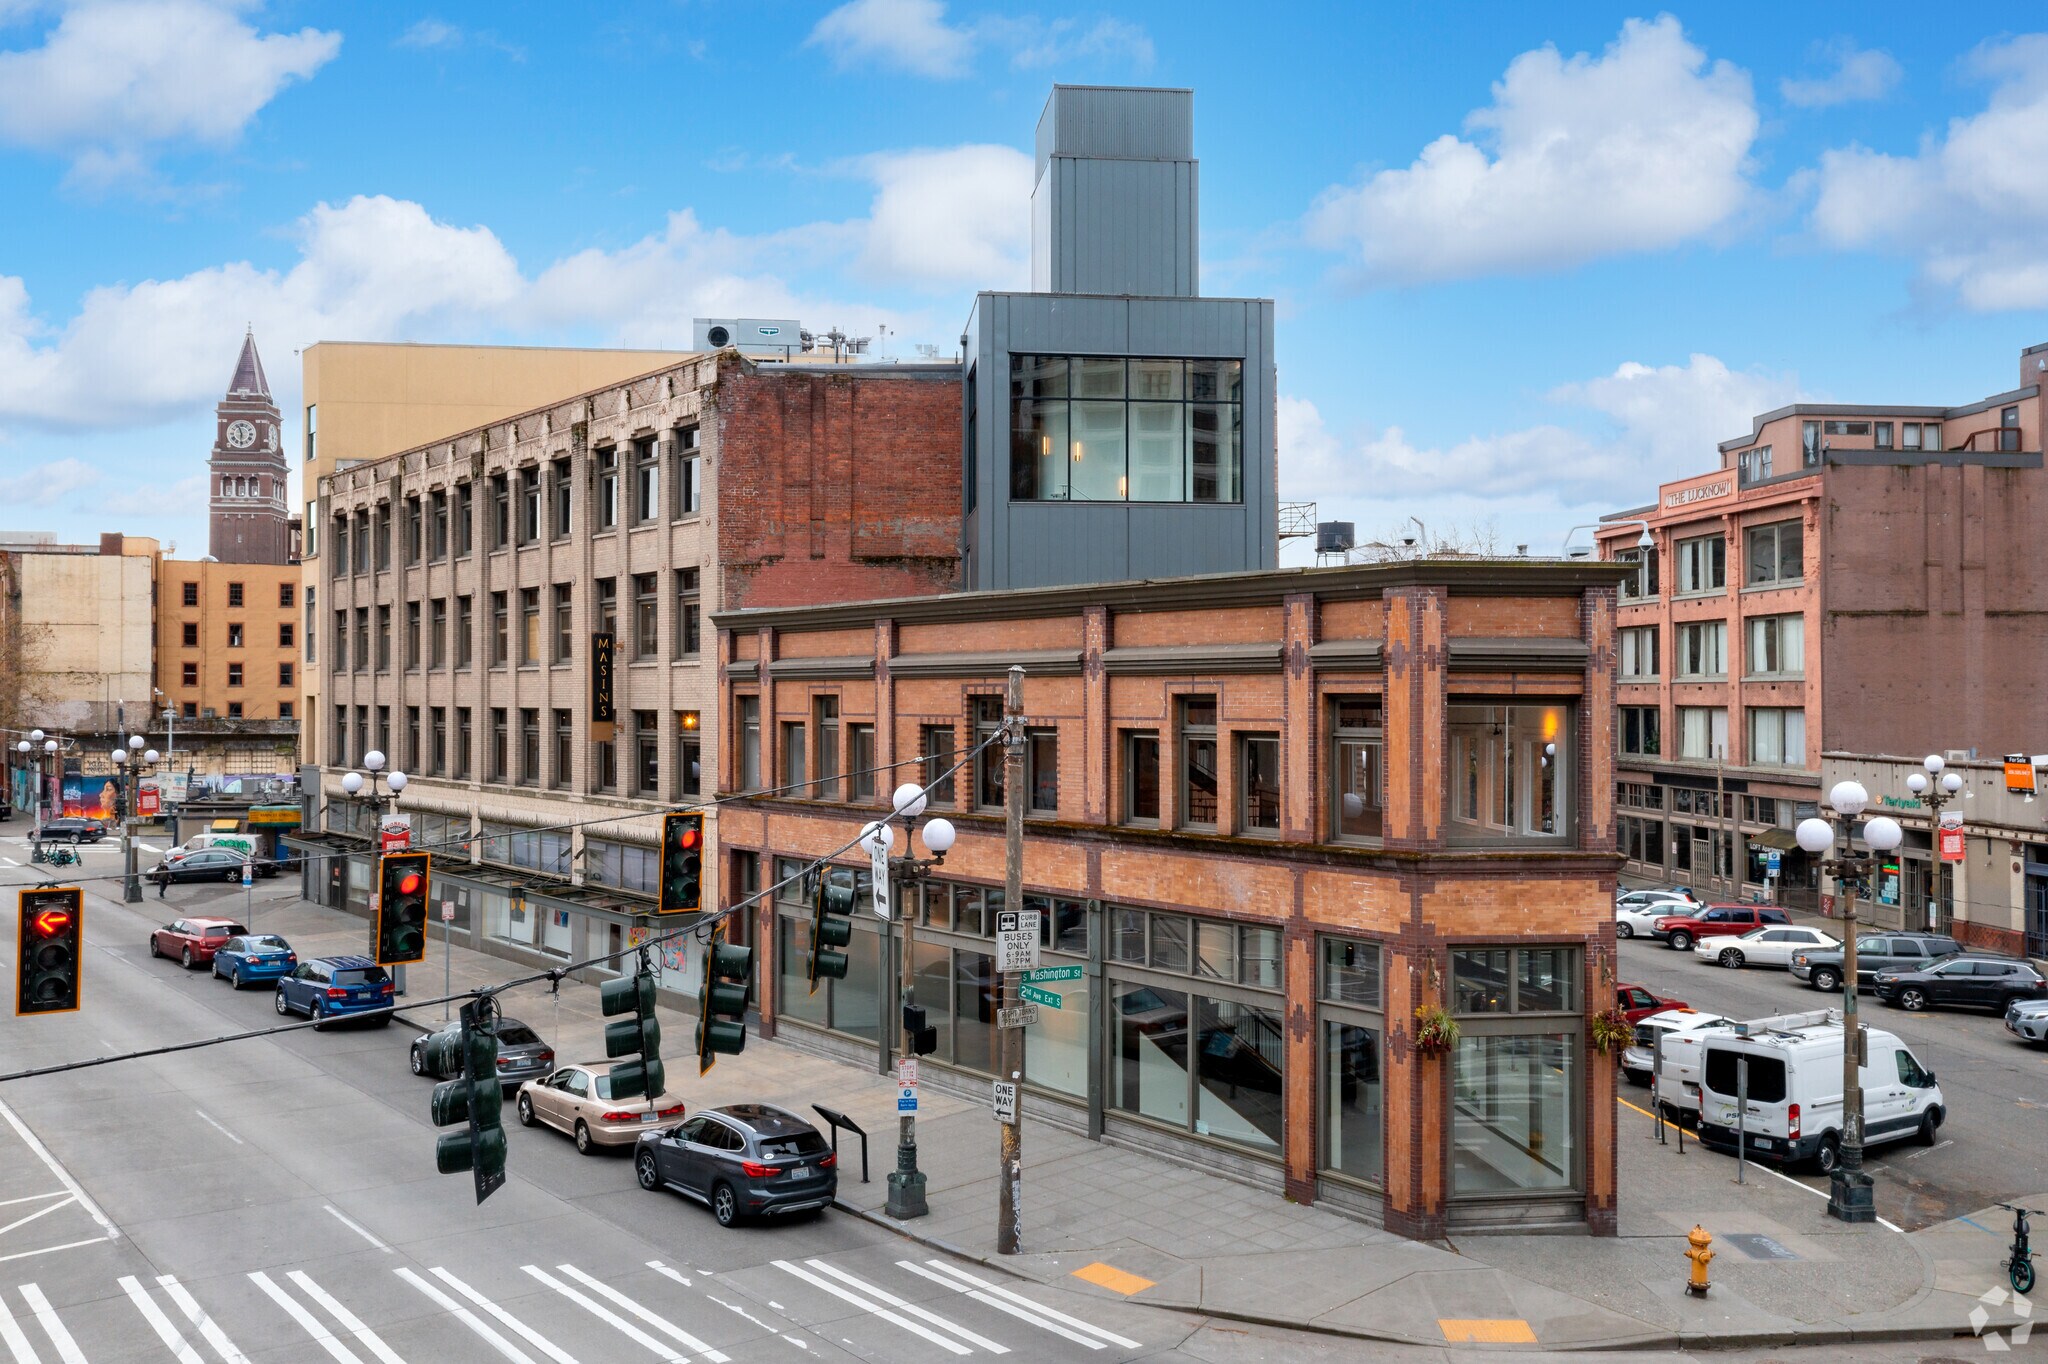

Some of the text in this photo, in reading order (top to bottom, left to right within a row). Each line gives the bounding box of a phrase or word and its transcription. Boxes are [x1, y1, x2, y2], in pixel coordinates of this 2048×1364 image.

[1670, 481, 1727, 506] THE LUCKNOW
[598, 638, 609, 717] MASINS
[1883, 795, 1921, 809] Teriyaki
[1750, 843, 1761, 851] LOFT
[874, 845, 885, 865] ONE
[874, 867, 886, 886] WAY
[1004, 932, 1033, 941] BUSES
[1007, 942, 1030, 950] ONLY
[1022, 973, 1027, 981] S
[1029, 969, 1070, 980] Washington
[1020, 985, 1061, 1006] 2nd Ave Ext S
[1001, 1007, 1036, 1019] RIGHT TURNS
[1003, 1015, 1034, 1026] PERMITTED
[995, 1084, 1013, 1096] ONE
[995, 1095, 1014, 1107] WAY
